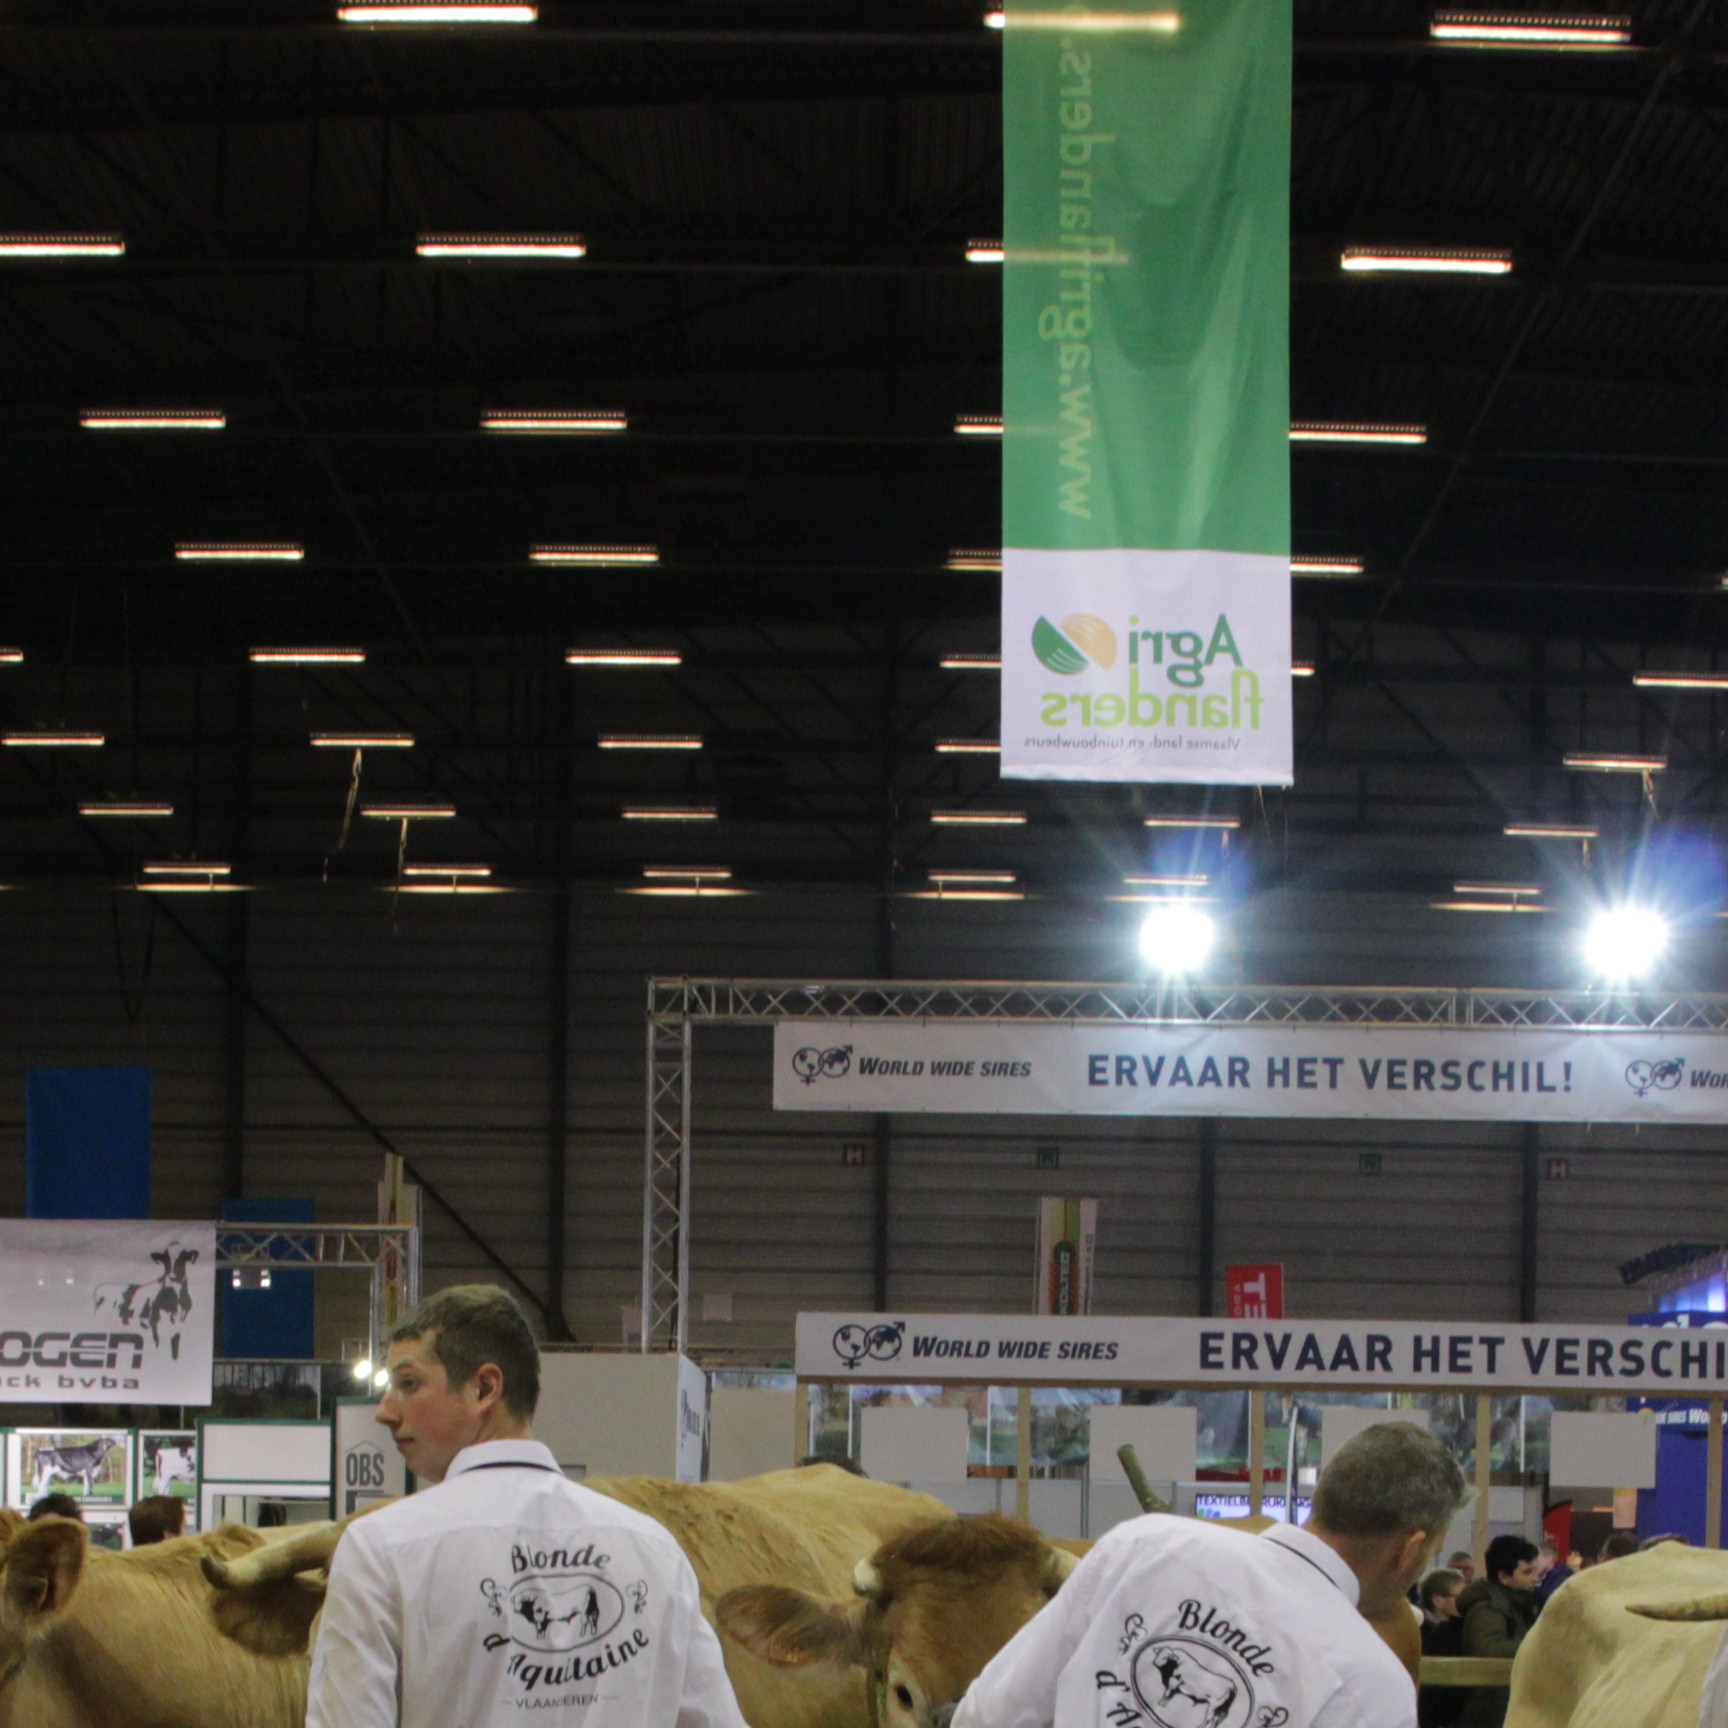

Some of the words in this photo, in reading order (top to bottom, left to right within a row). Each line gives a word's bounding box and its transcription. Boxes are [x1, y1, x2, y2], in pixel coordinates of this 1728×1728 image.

[1088, 1054, 1251, 1088] ERVAAR
[1267, 1057, 1344, 1089] HET
[1359, 1058, 1572, 1092] VERSCHIL!
[1243, 1272, 1267, 1318] TE
[1199, 1331, 1393, 1372] ERVAAR
[1412, 1335, 1505, 1374] HET
[58, 1374, 140, 1390] bvba
[346, 1453, 385, 1487] OBS
[512, 1543, 611, 1574] Blonde
[1179, 1600, 1275, 1678] Blonde
